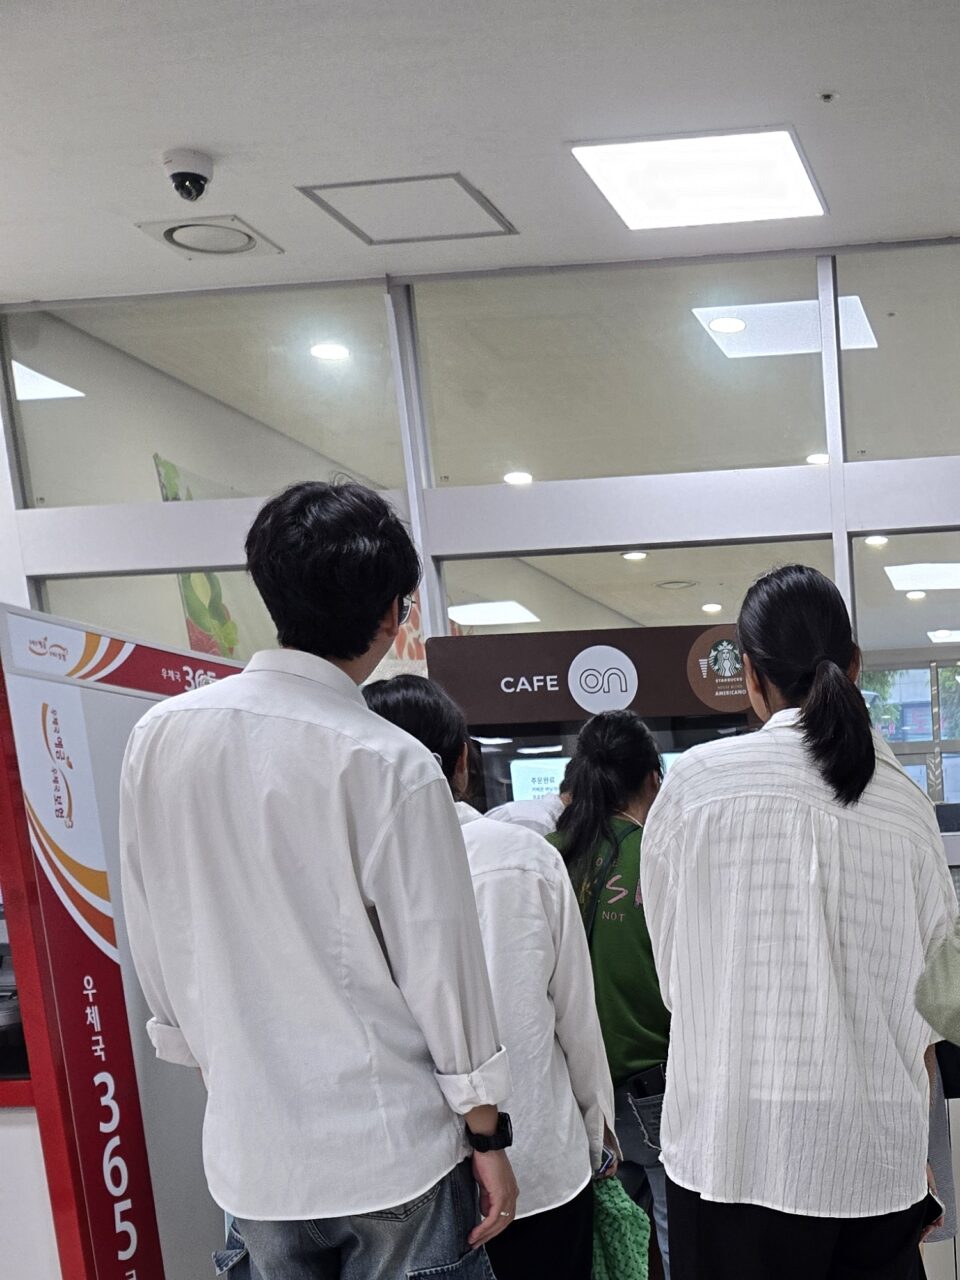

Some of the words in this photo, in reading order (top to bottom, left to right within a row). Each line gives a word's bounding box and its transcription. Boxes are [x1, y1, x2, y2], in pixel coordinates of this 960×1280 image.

[500, 674, 560, 693] CAFE
[579, 667, 628, 694] on
[601, 910, 625, 923] NOT
[82, 974, 106, 1062] 우체국
[92, 1071, 138, 1262] 365
